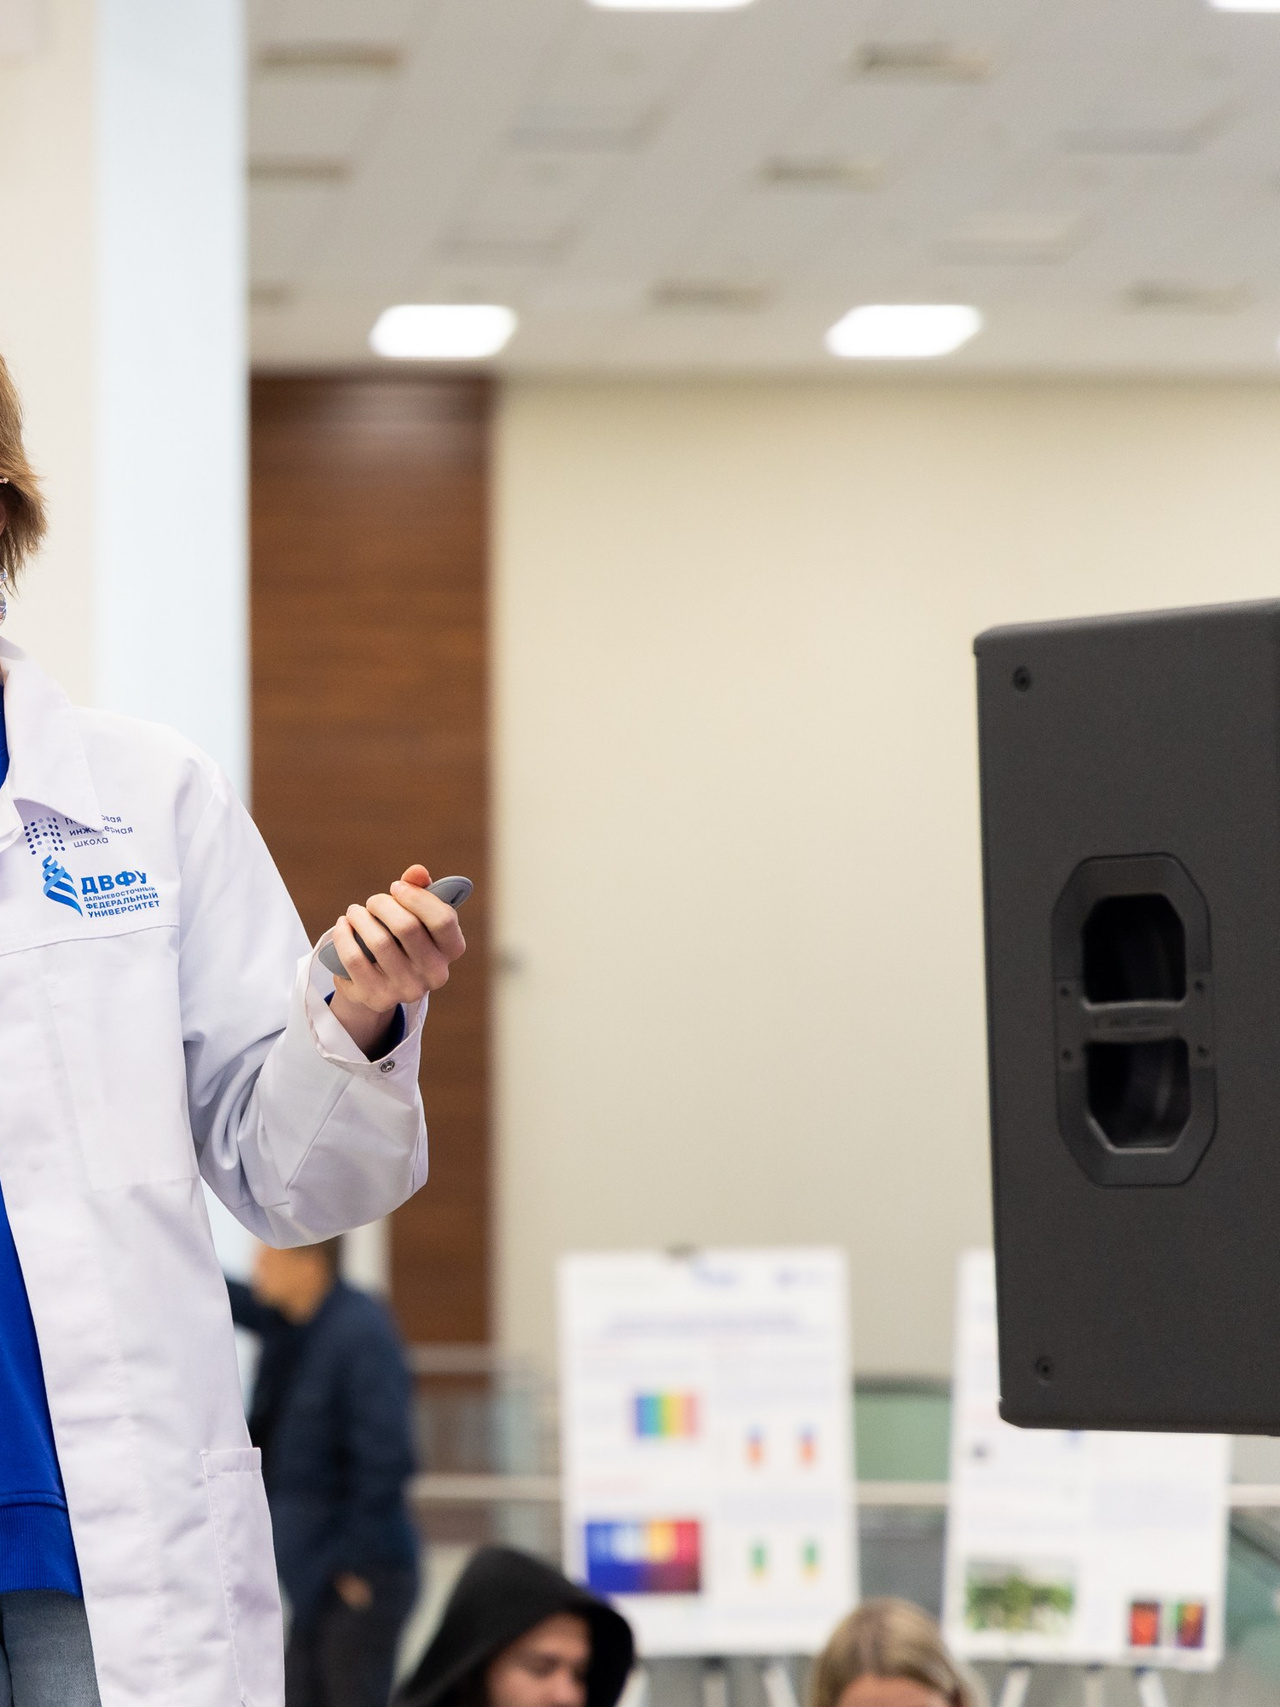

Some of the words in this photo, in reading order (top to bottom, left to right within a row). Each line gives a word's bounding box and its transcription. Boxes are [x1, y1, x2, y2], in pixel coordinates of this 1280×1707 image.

[73, 837, 109, 848] школа
[81, 870, 147, 895] ДВФУ
[85, 891, 159, 909] ФЕДЕРАЛЬНЫЙ
[88, 900, 160, 918] УНИВЕРСИТЕТ
